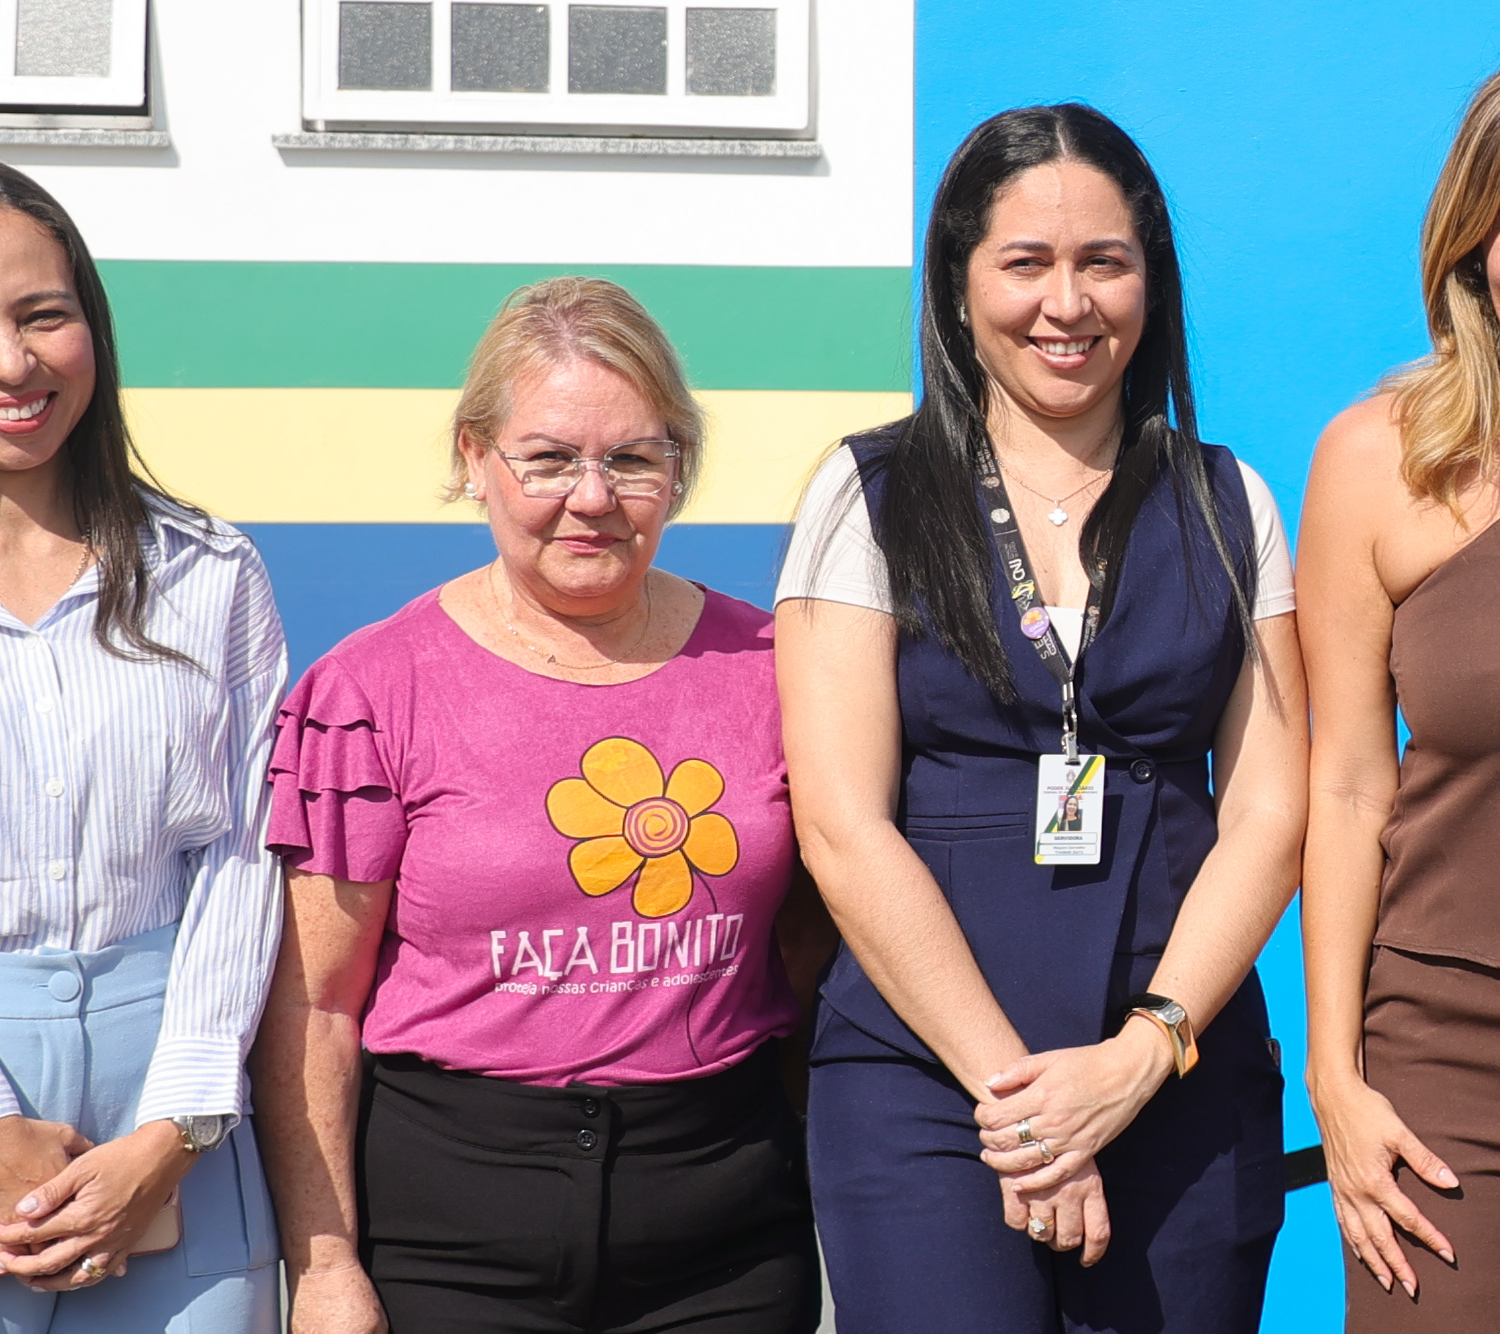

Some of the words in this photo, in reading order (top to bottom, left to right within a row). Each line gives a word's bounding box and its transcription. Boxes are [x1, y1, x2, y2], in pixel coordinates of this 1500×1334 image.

[490, 926, 600, 981] FAÇA
[610, 913, 744, 975] BONITO
[494, 981, 537, 996] proteja
[541, 981, 587, 995] nossas
[651, 976, 660, 987] e
[662, 964, 740, 987] adolescentes
